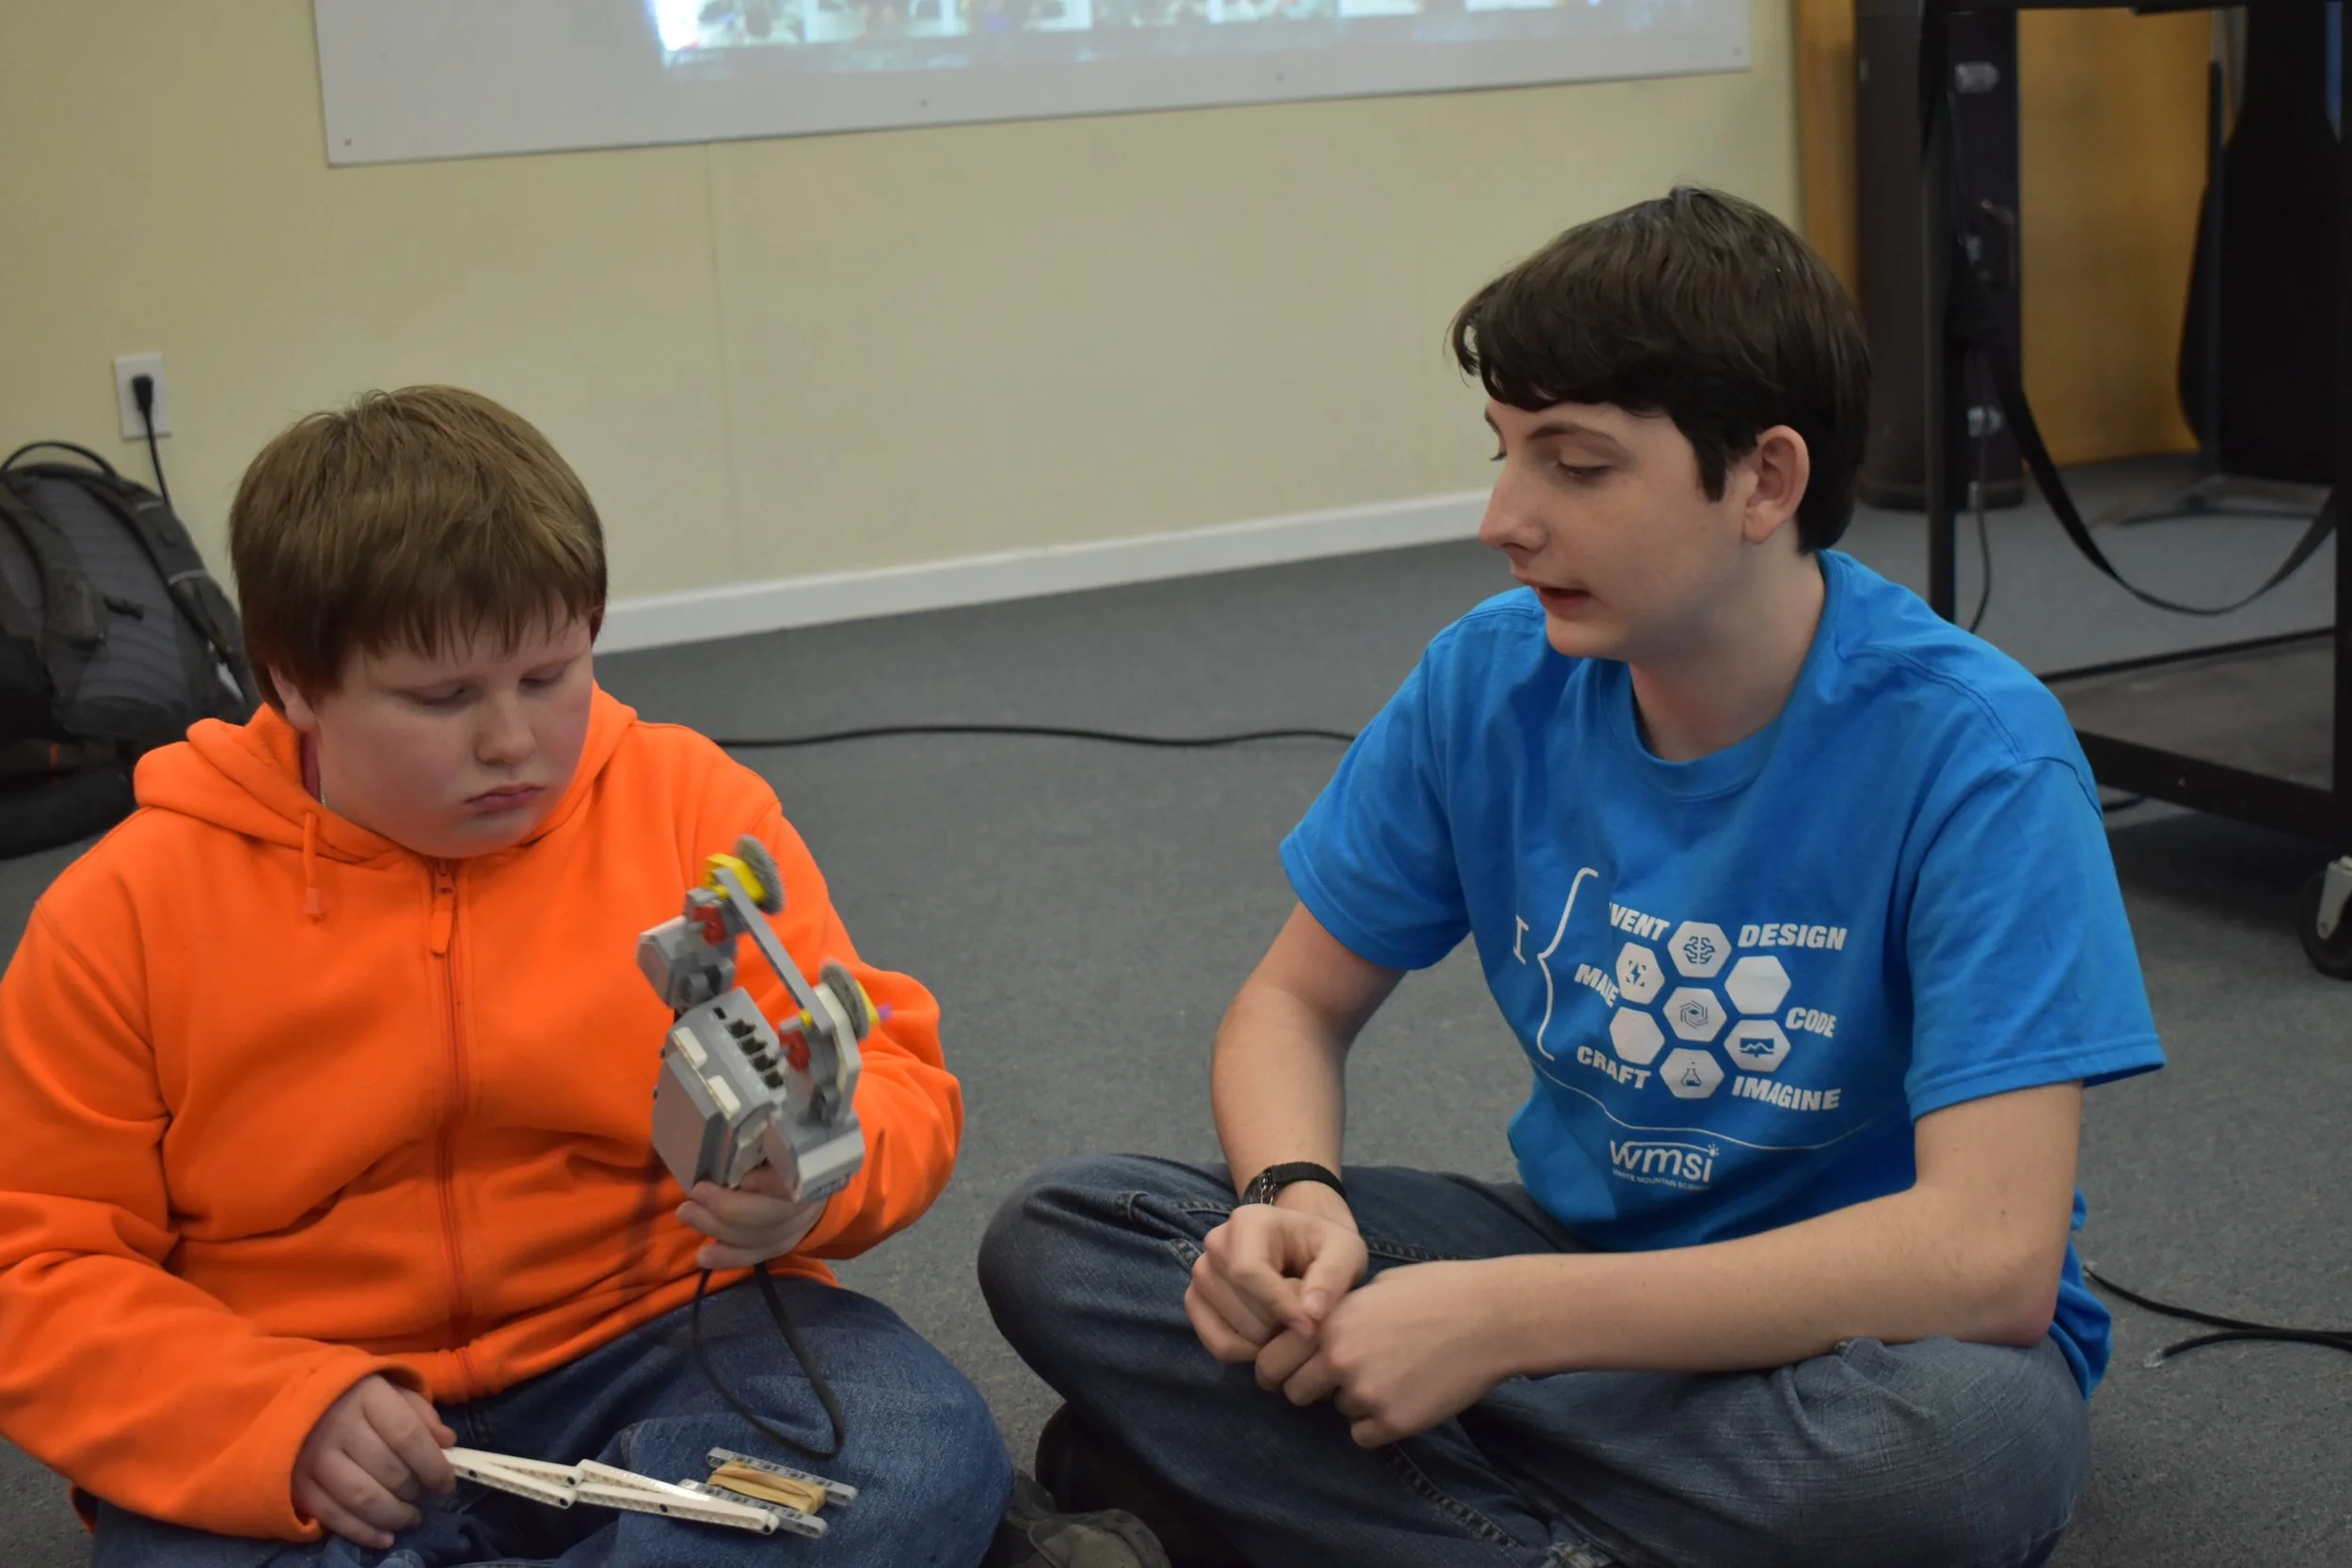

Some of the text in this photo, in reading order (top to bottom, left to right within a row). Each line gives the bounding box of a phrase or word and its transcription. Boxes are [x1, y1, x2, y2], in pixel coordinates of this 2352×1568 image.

[1610, 901, 1671, 941] VENT
[1738, 924, 1847, 951] DESIGN
[1785, 1006, 1836, 1037] CODE
[1577, 1045, 1651, 1088] CRAFT
[1731, 1075, 1841, 1111] IMAGINE
[1610, 1140, 1719, 1182] wmsi
